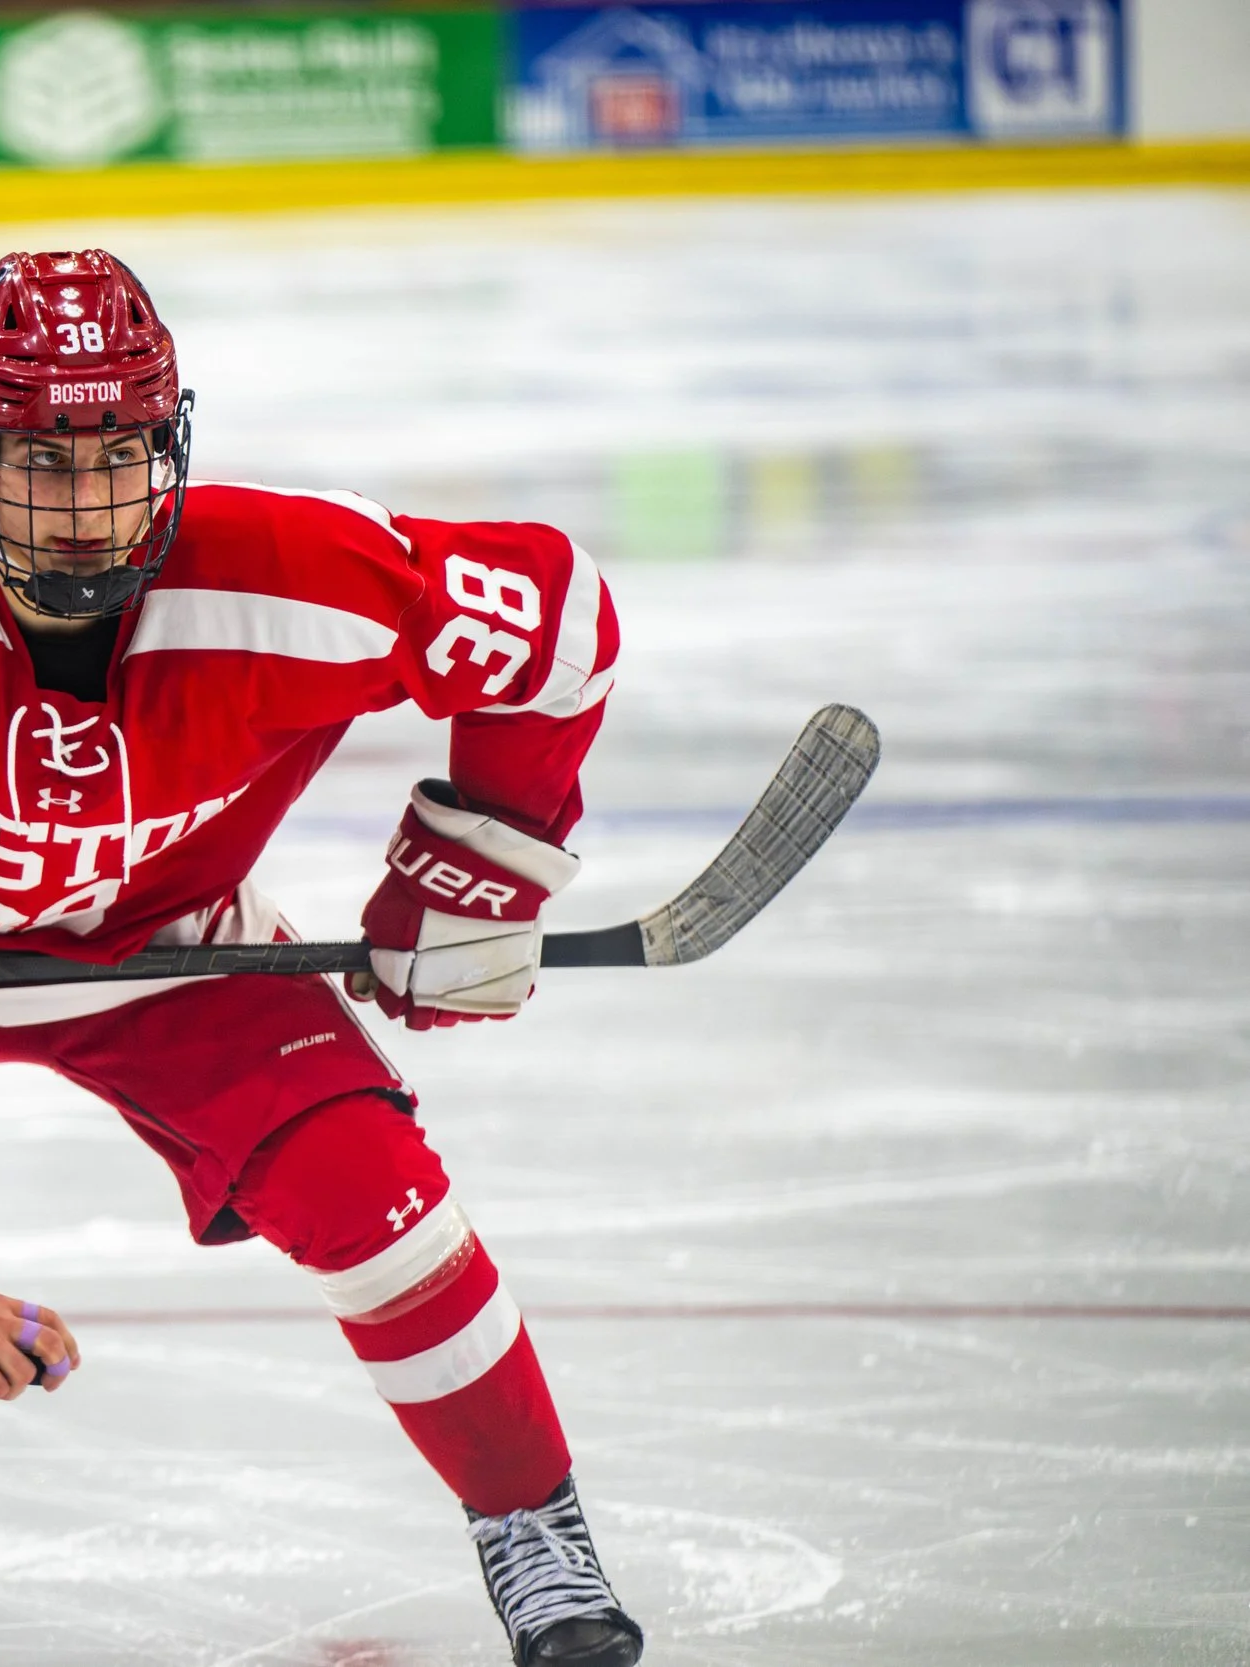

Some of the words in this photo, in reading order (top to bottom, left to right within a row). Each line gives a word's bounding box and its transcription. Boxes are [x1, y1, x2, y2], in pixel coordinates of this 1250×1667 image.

[56, 321, 105, 355] 38
[49, 381, 123, 405] BOSTON
[425, 553, 541, 696] 38
